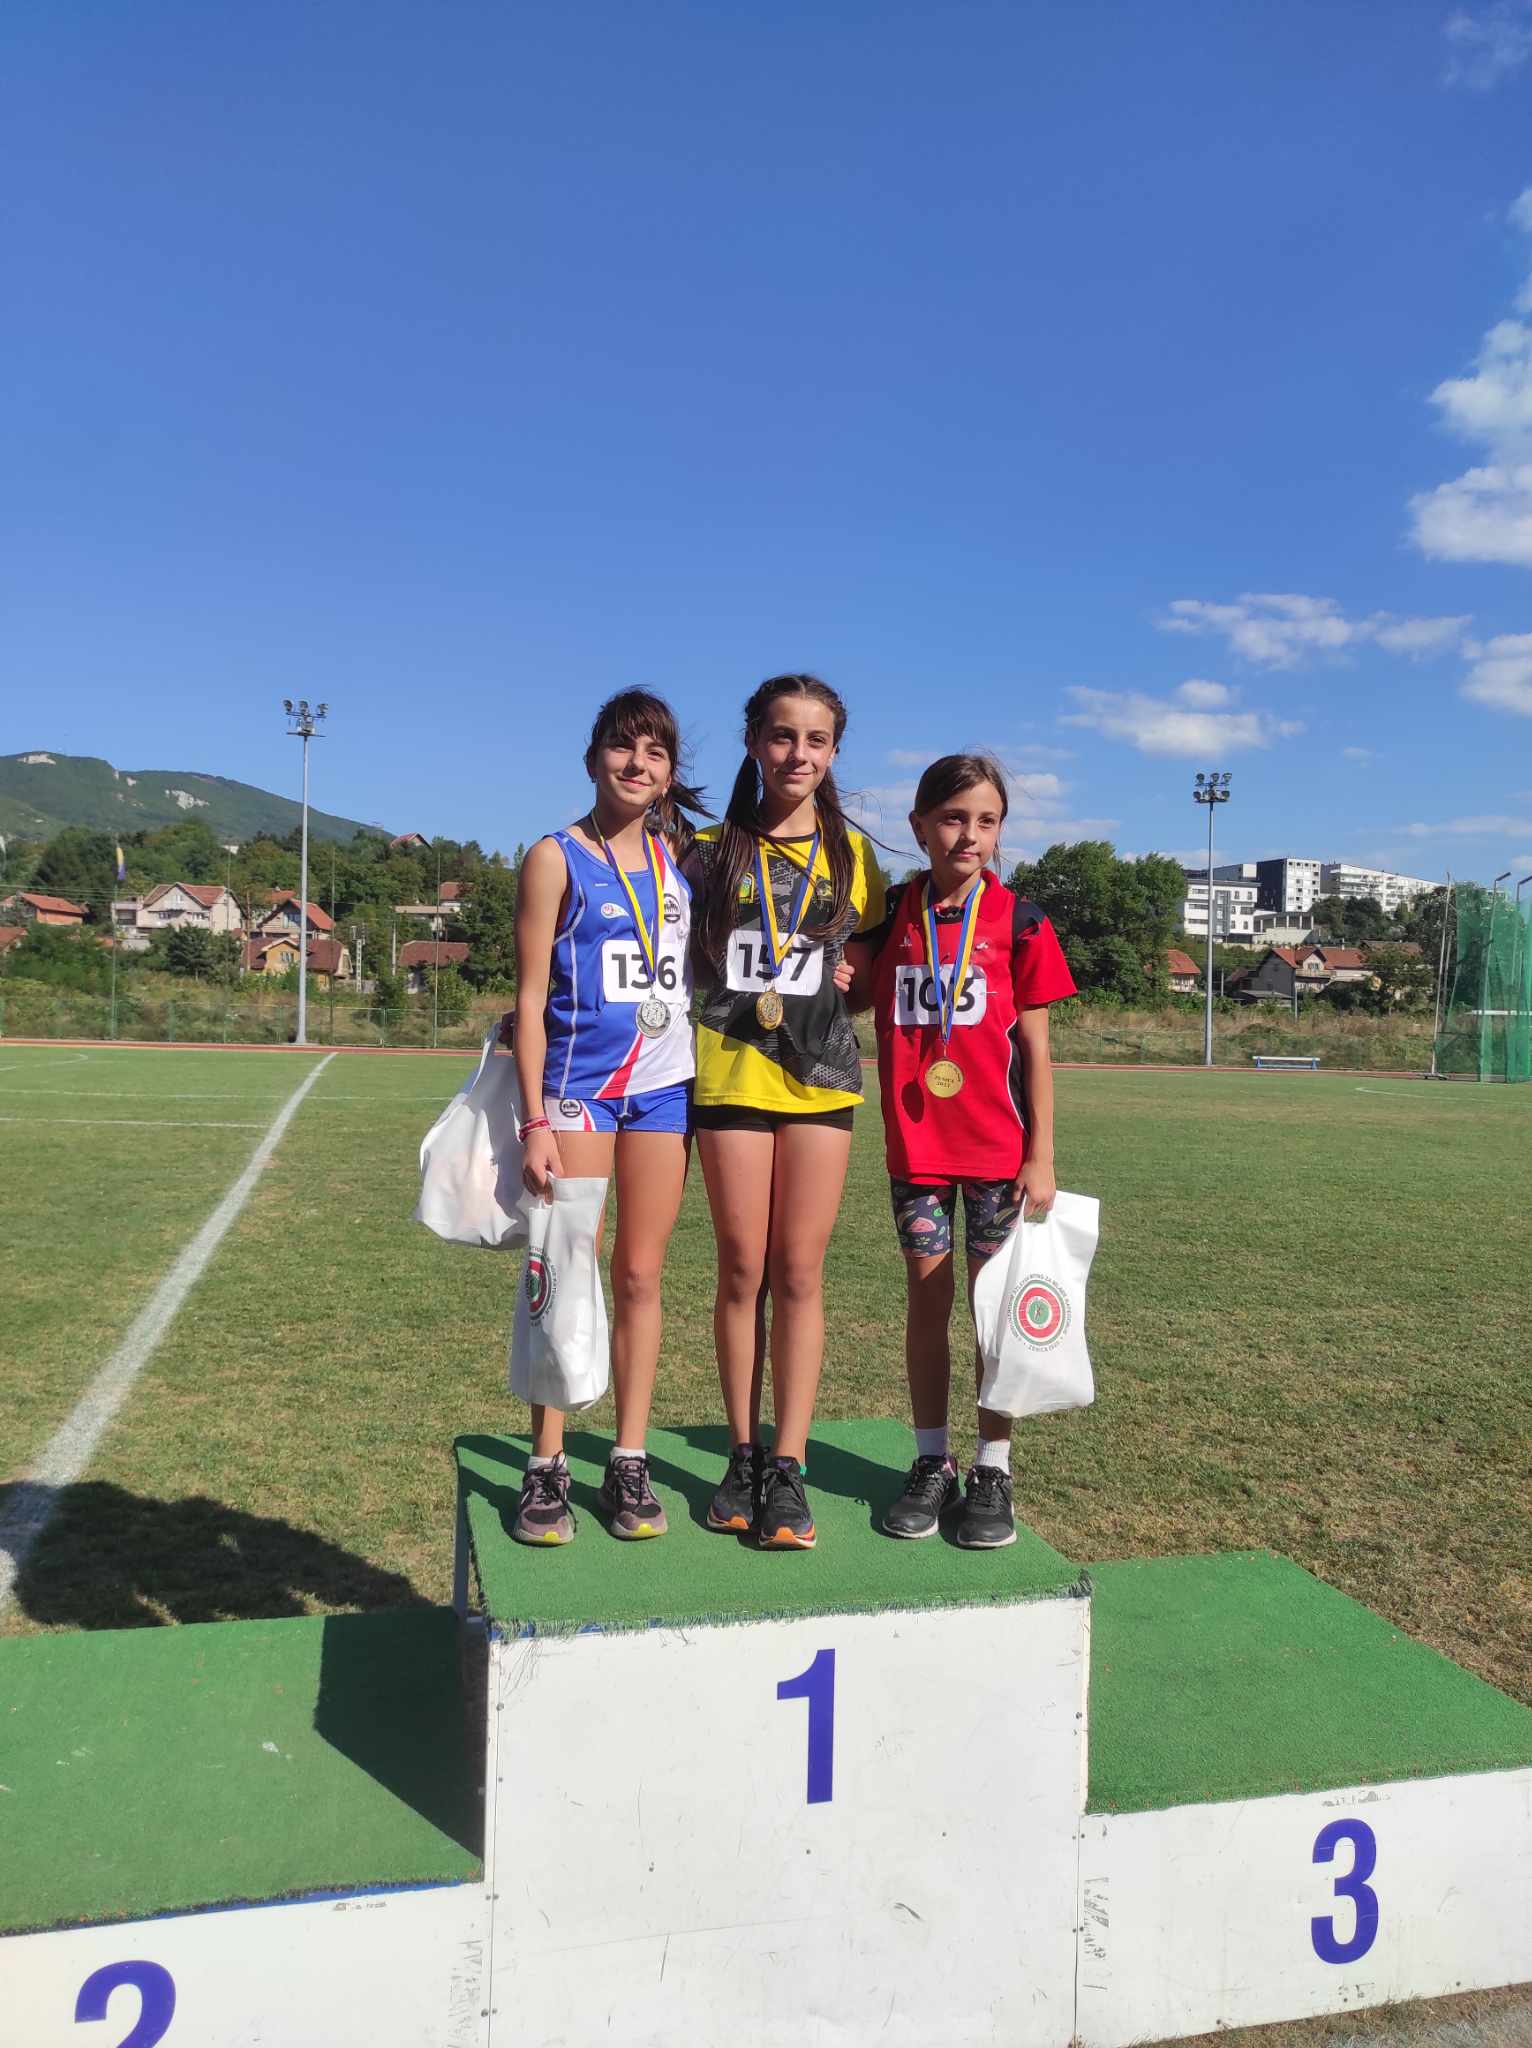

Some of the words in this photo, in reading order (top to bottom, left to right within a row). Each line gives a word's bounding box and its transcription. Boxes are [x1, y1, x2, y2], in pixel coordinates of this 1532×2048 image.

[611, 952, 677, 991] 136
[738, 943, 812, 982] 157
[778, 1648, 834, 1802] 1
[1312, 1820, 1377, 1963] 3
[76, 1961, 174, 2048] 2
